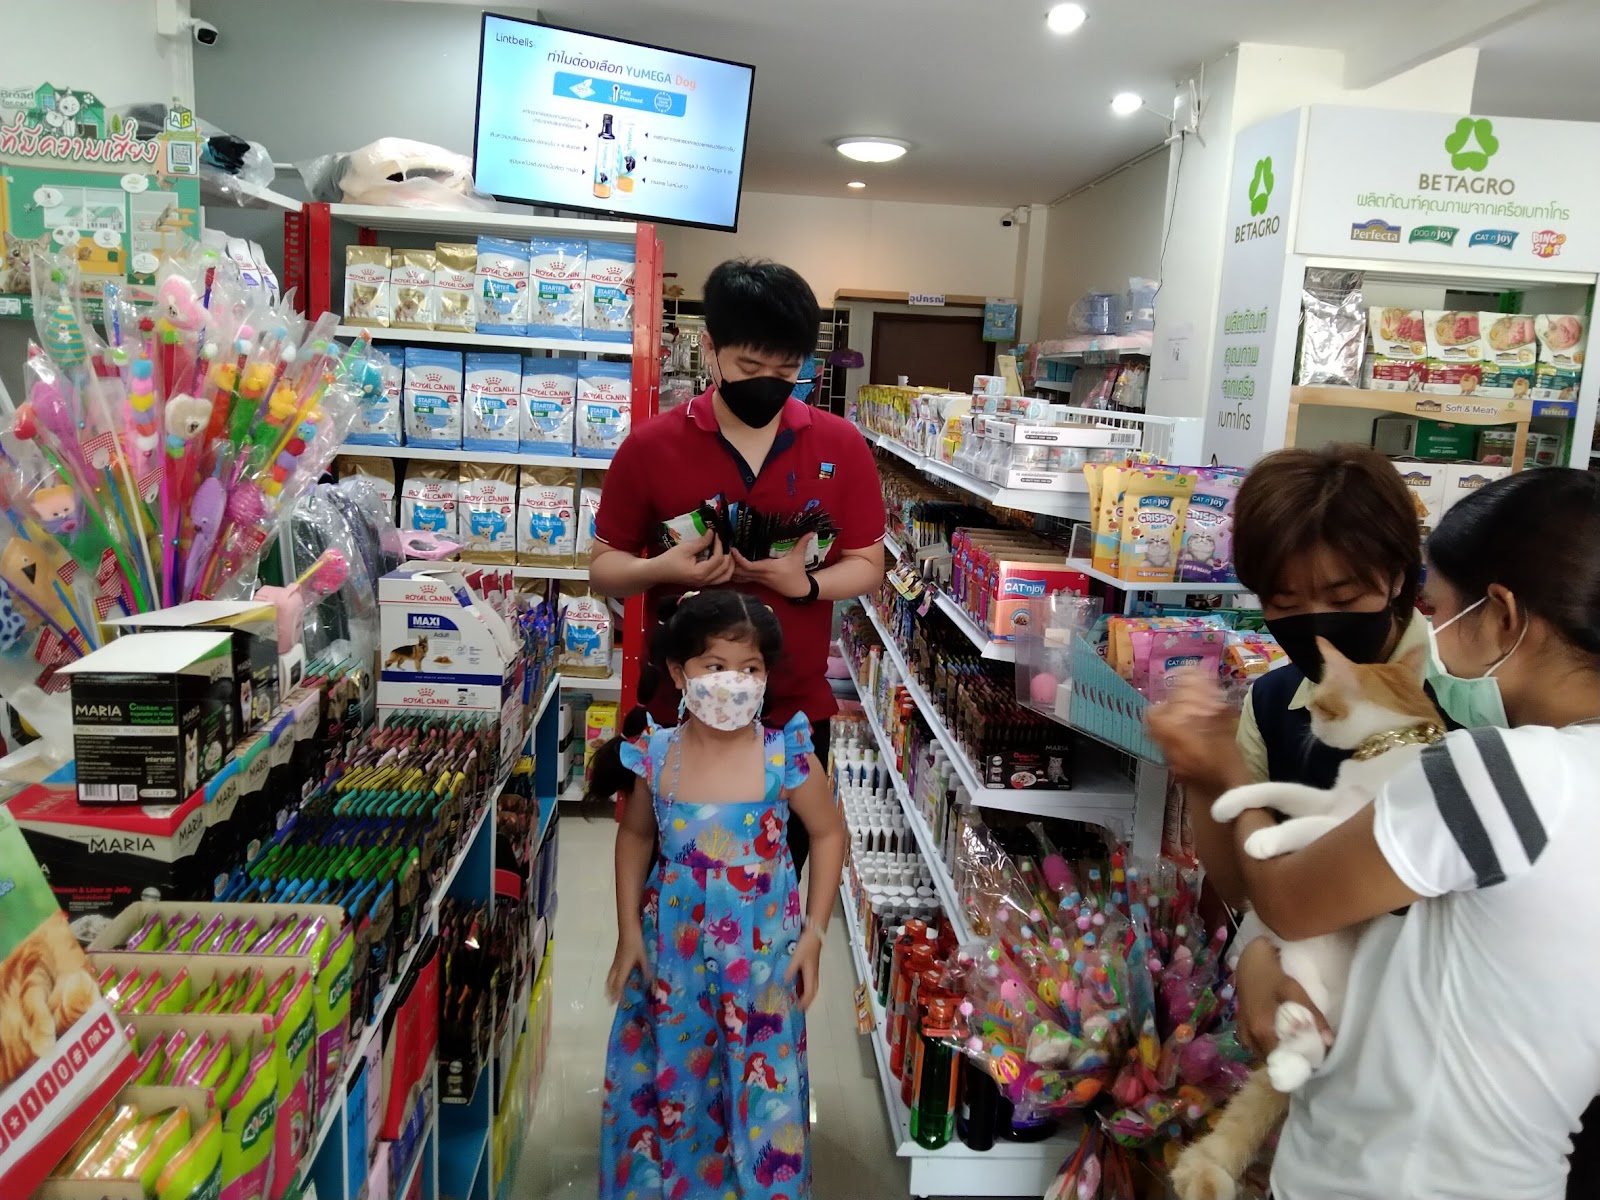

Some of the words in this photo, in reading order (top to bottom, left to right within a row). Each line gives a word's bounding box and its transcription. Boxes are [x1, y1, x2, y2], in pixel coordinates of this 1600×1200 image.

[495, 33, 534, 49] Lintbells
[547, 50, 623, 76] ทำไมต้องเลือก
[675, 75, 697, 92] Dog
[172, 115, 191, 129] AR
[1418, 173, 1516, 195] BETAGRO
[1356, 192, 1570, 221] ผลิตภัณฑ์คุณภาพจากเครือเบทาโกร
[1234, 215, 1280, 243] BETAGRO
[1413, 229, 1430, 237] DOG
[1353, 228, 1398, 242] Perfecta
[1475, 233, 1489, 241] CAT
[1532, 231, 1566, 245] BINGO
[481, 267, 502, 277] ROYAL
[503, 270, 525, 280] CANIN
[591, 274, 614, 284] ROYAL
[541, 286, 565, 296] STARTER
[909, 294, 945, 306] อุปกรณ์
[410, 381, 433, 391] ROYAL
[434, 384, 456, 393] CANIN
[471, 383, 493, 393] ROYAL
[527, 388, 547, 396] ROYAL
[417, 396, 442, 405] STARTER
[583, 392, 604, 400] ROYAL
[533, 403, 557, 411] STARTER
[1445, 404, 1463, 413] Soft
[1464, 405, 1470, 413] &
[1472, 406, 1498, 416] Meaty
[1540, 407, 1569, 416] Perfecta
[1217, 402, 1252, 431] เบทาโกร
[432, 491, 453, 499] CANIN
[526, 498, 547, 507] ROYAL
[1138, 512, 1176, 525] CRISPY
[405, 594, 427, 602] ROYAL
[429, 595, 452, 603] CANIN
[567, 611, 582, 620] OYAL
[412, 616, 441, 627] MAXI
[433, 631, 450, 640] Adult
[403, 697, 425, 705] ROYAL
[426, 698, 450, 706] CANIN
[75, 704, 123, 717] MARIA
[129, 702, 159, 712] Chicken
[179, 811, 205, 846] MARIA
[90, 837, 156, 854] MARIA
